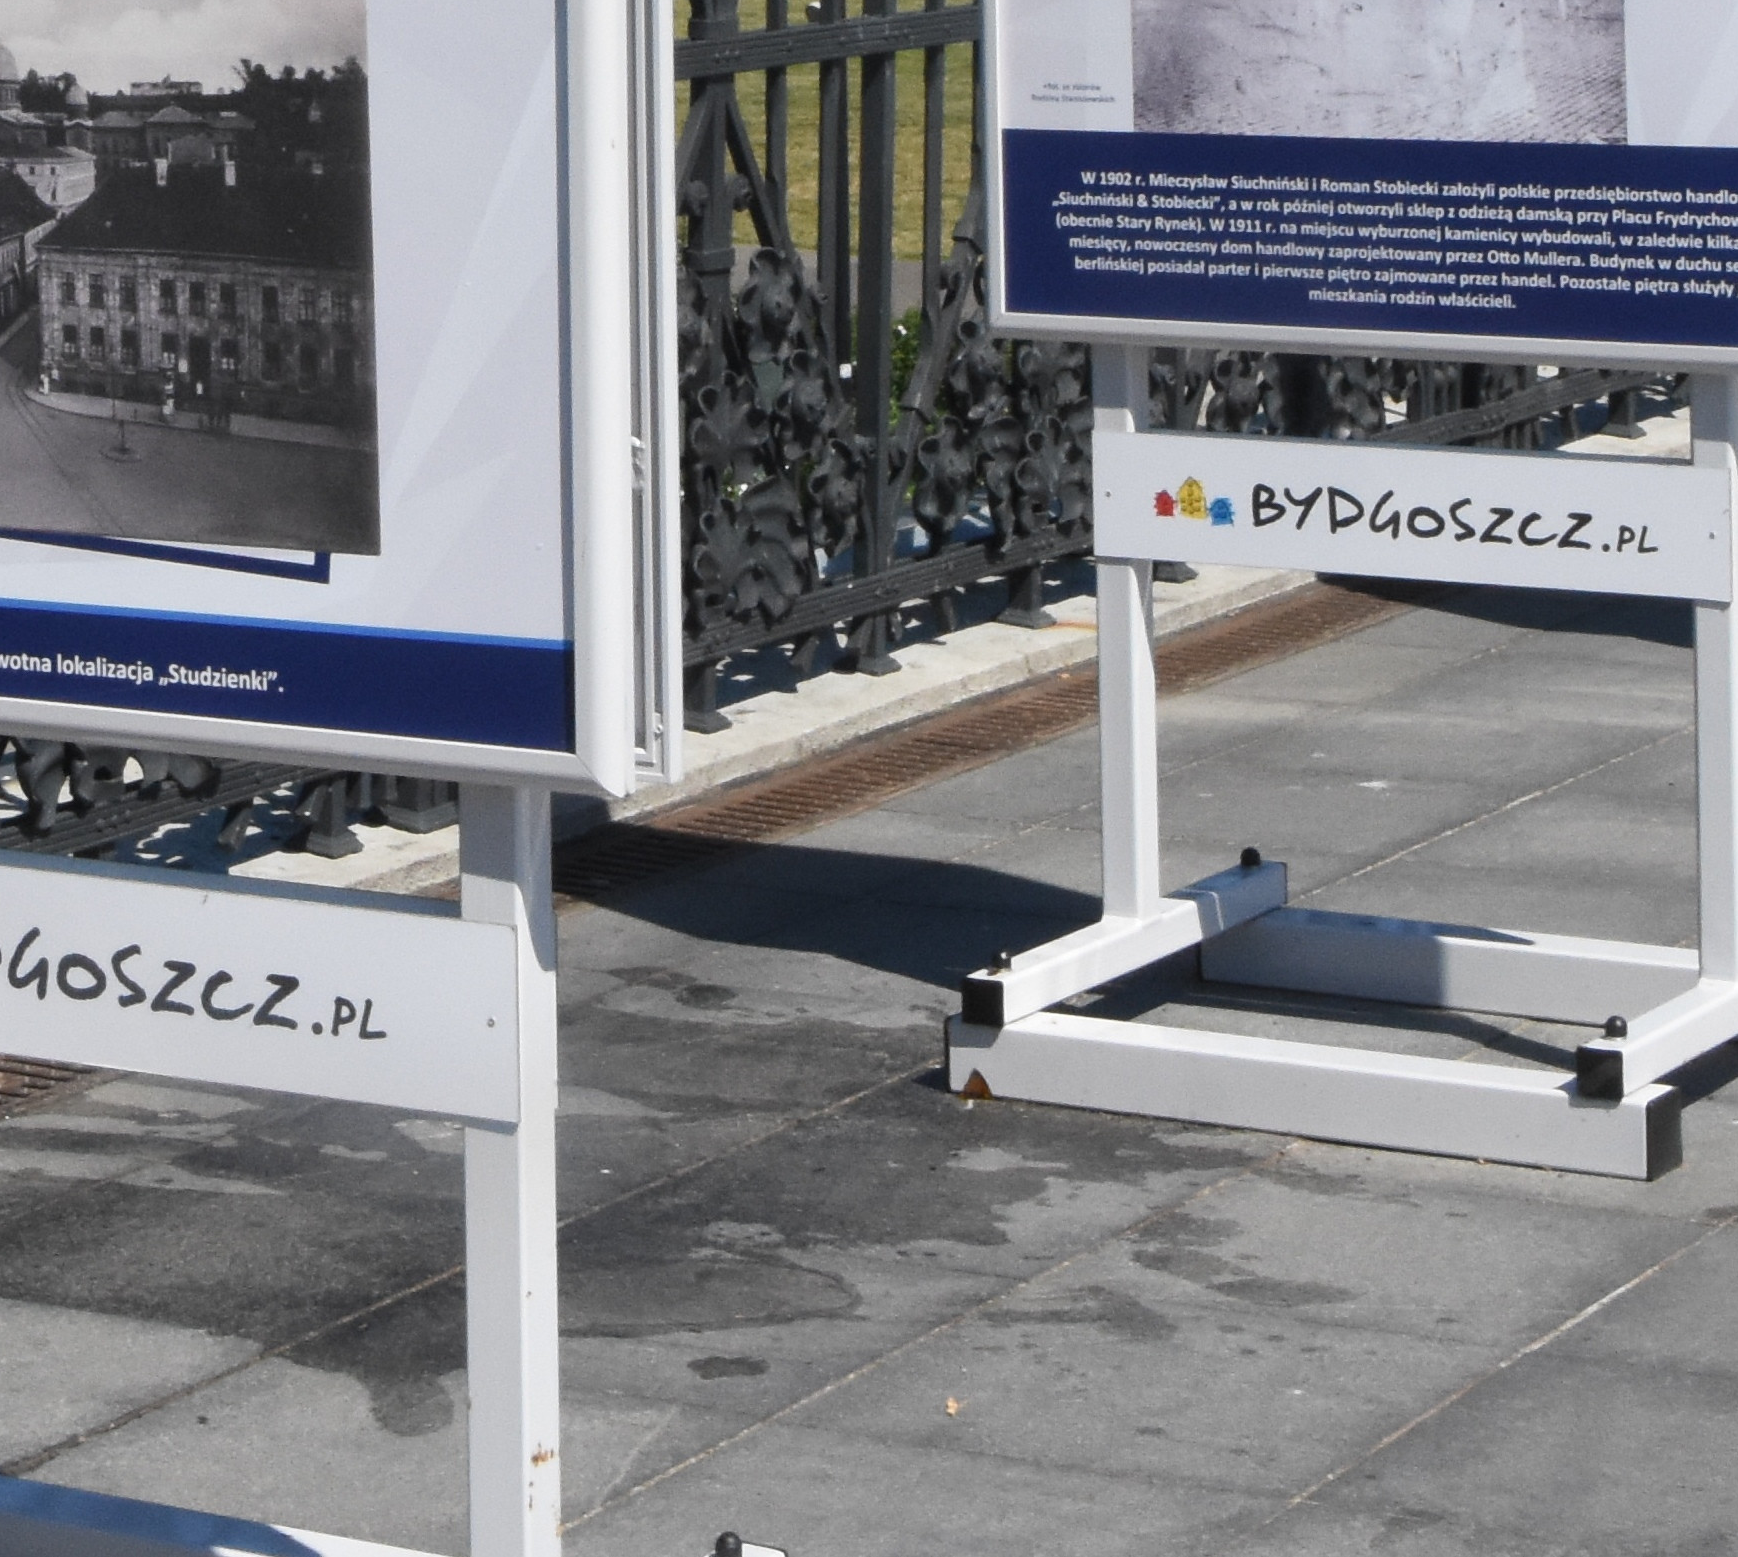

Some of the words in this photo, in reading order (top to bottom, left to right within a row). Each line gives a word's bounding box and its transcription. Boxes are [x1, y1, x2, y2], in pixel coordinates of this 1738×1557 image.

[1080, 171, 1096, 184] W
[1099, 171, 1132, 186] 1902
[1134, 175, 1146, 186] r.
[1148, 172, 1228, 191] Mieczysław
[1230, 175, 1309, 191] Siuchniński
[1311, 177, 1317, 191] i
[1319, 177, 1370, 193] Roman
[1372, 179, 1439, 195] Stobiecki
[1441, 181, 1495, 200] założyli
[1498, 183, 1551, 200] polskie
[1553, 185, 1682, 204] przedsiębiorstwo
[1135, 193, 1149, 208] &
[1227, 199, 1237, 210] a
[1239, 200, 1254, 211] w
[1255, 197, 1280, 212] rok
[1282, 198, 1334, 217] później
[1336, 201, 1404, 219] otworzyli
[1406, 202, 1445, 221] sklep
[1446, 206, 1456, 218] z
[1457, 204, 1513, 223] odzieżą
[1515, 205, 1574, 225] damską
[1575, 210, 1609, 226] przy
[1611, 208, 1652, 224] Placu
[1055, 211, 1113, 228] (obecnie
[1116, 214, 1151, 232] Stary
[1154, 215, 1204, 234] Rynek).
[1208, 217, 1224, 231] W
[1229, 218, 1261, 233] 1911
[1265, 222, 1275, 233] r.
[1279, 222, 1297, 234] na
[1300, 221, 1354, 238] miejscu
[1357, 223, 1440, 242] wyburzonej
[1444, 225, 1517, 245] kamienicy
[1520, 228, 1615, 248] wybudowali,
[1619, 234, 1633, 246] w
[1636, 231, 1703, 249] zaledwie
[1068, 234, 1130, 252] miesięcy,
[1134, 239, 1217, 256] nowoczesny
[1220, 239, 1252, 254] dom
[1256, 240, 1324, 260] handlowy
[1328, 244, 1442, 265] zaprojektowany
[1445, 250, 1483, 265] przez
[1487, 249, 1520, 264] Otto
[1524, 250, 1584, 267] Mullera.
[1589, 252, 1654, 271] Budynek
[1657, 258, 1671, 270] w
[1675, 255, 1721, 272] duchu
[1074, 255, 1144, 275] berlińskiej
[1146, 259, 1205, 275] posiadał
[1207, 262, 1251, 277] parter
[1253, 262, 1259, 276] i
[1261, 262, 1324, 279] pierwsze
[1326, 265, 1372, 283] piętro
[1373, 267, 1456, 285] zajmowane
[1458, 273, 1498, 288] przez
[1500, 271, 1556, 288] handel.
[1558, 274, 1631, 291] Pozostałe
[1634, 277, 1680, 295] piętra
[1682, 278, 1734, 298] służyły
[1308, 286, 1386, 303] mieszkania
[1390, 289, 1434, 305] rodzin
[1438, 291, 1516, 308] właścicieli.
[1251, 483, 1659, 554] BYDGOSZCZ.PL
[55, 652, 154, 685] lokalizacja
